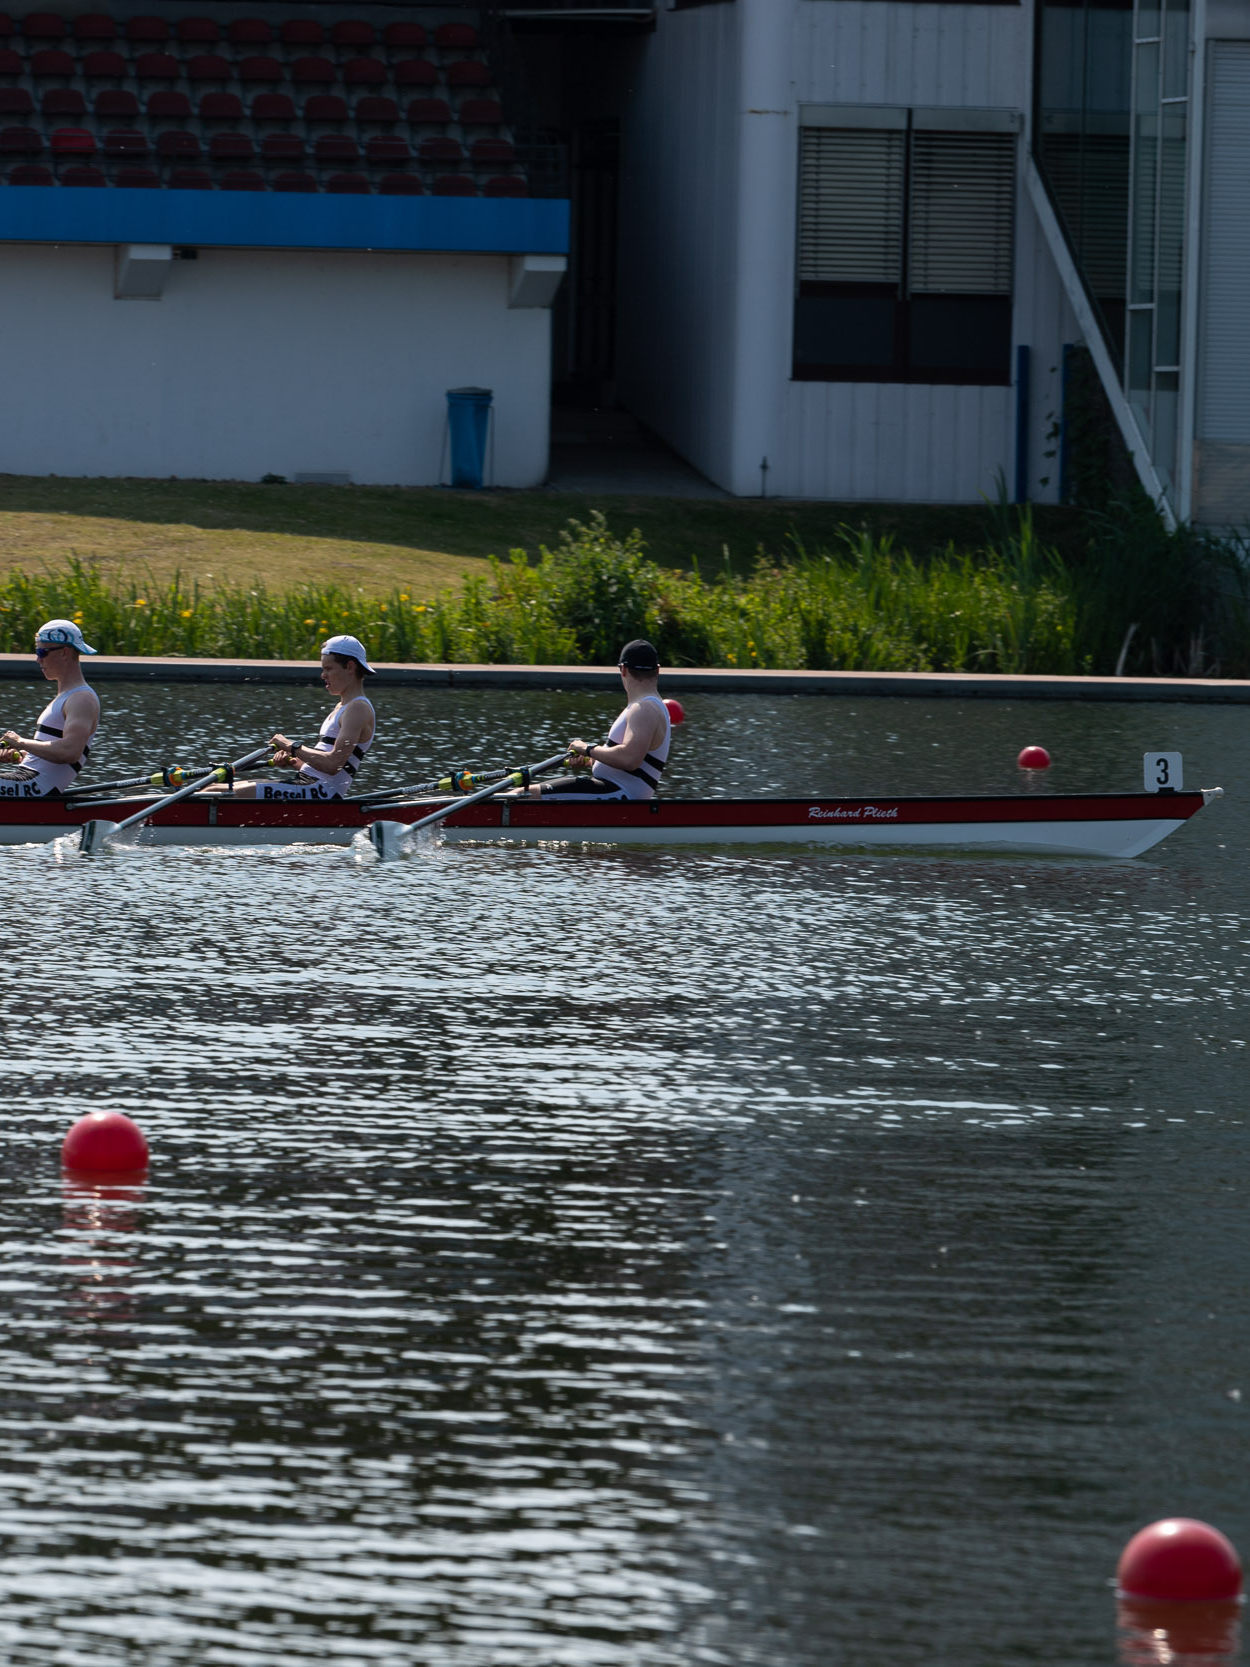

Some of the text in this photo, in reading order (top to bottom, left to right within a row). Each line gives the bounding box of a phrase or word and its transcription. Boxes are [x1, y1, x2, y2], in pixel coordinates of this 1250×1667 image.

[1156, 758, 1169, 785] 3
[23, 781, 41, 797] RC
[310, 784, 328, 799] RC
[808, 806, 898, 818] Reinhard Plieth
